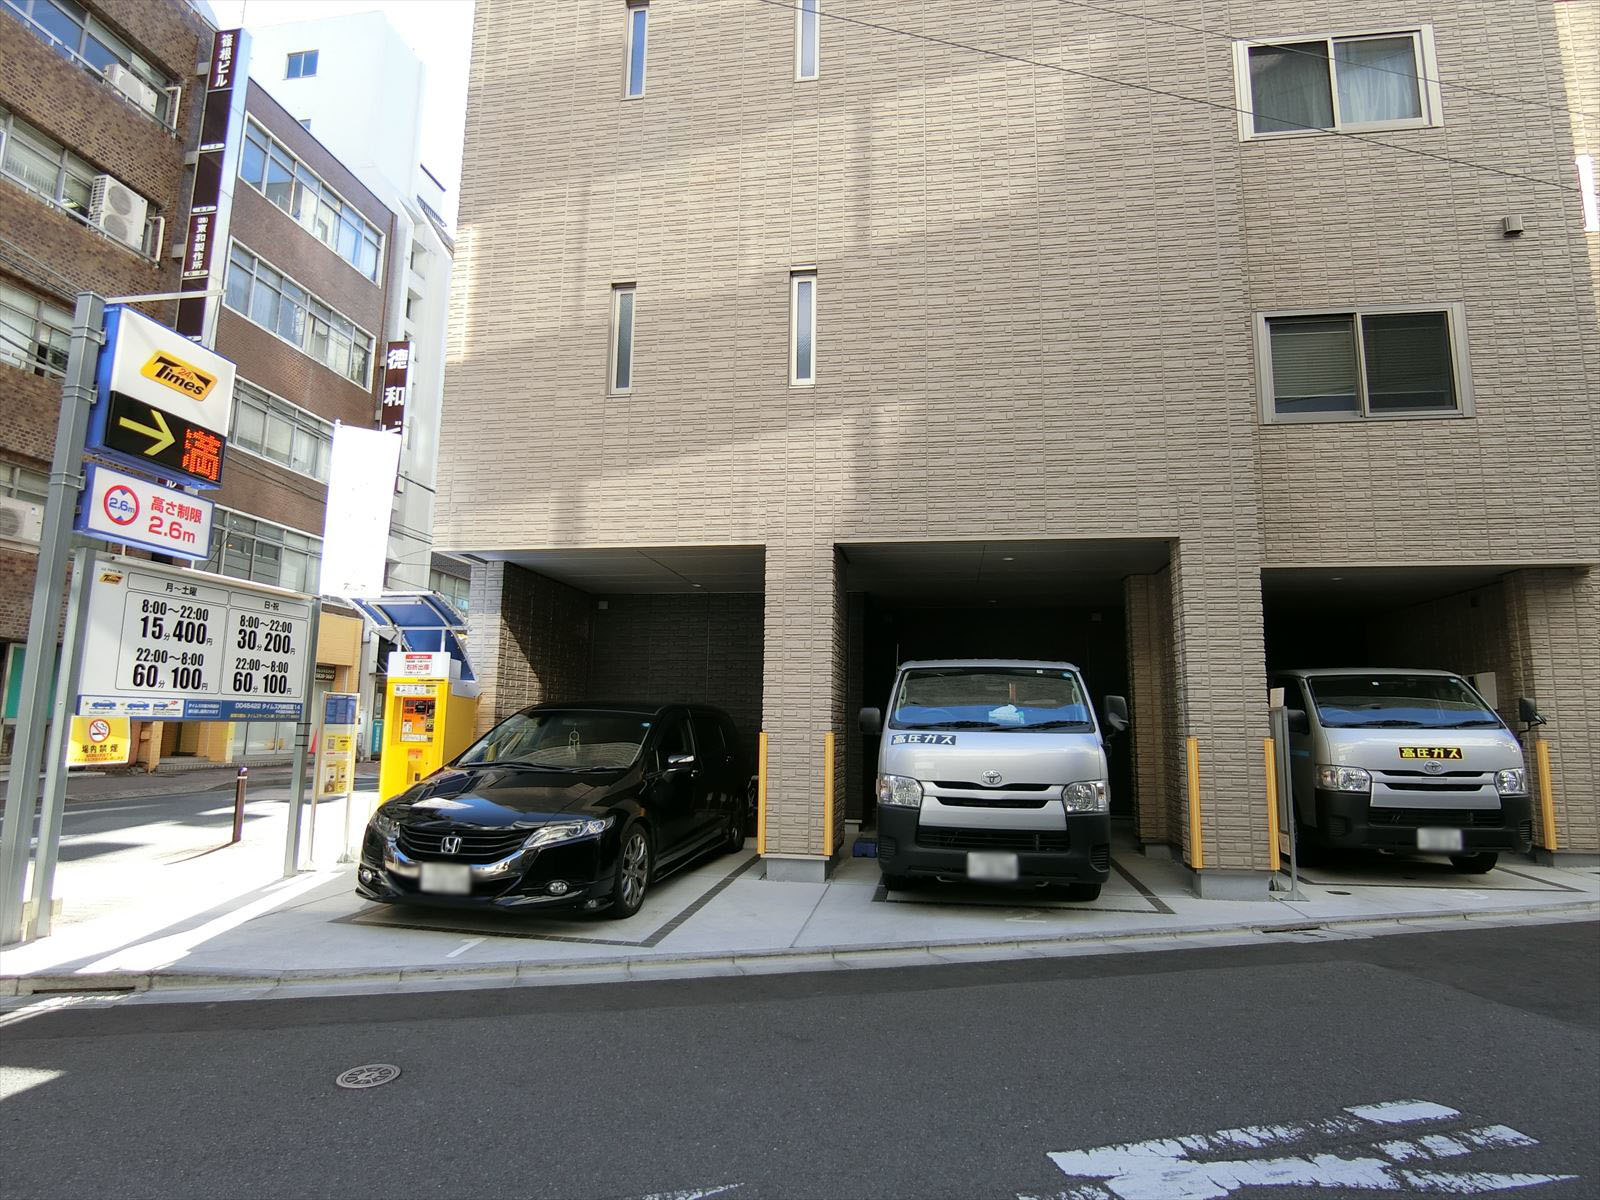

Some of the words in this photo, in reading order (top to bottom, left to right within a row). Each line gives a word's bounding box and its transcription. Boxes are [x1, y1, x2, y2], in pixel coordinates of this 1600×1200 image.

[153, 356, 208, 394] Times
[181, 428, 221, 480] 満
[109, 497, 135, 513] 2.6m
[150, 496, 202, 524] 高さ制限
[148, 516, 195, 544] 2.6m
[893, 734, 953, 744] 高圧ガス
[1401, 747, 1460, 759] 高圧ガス
